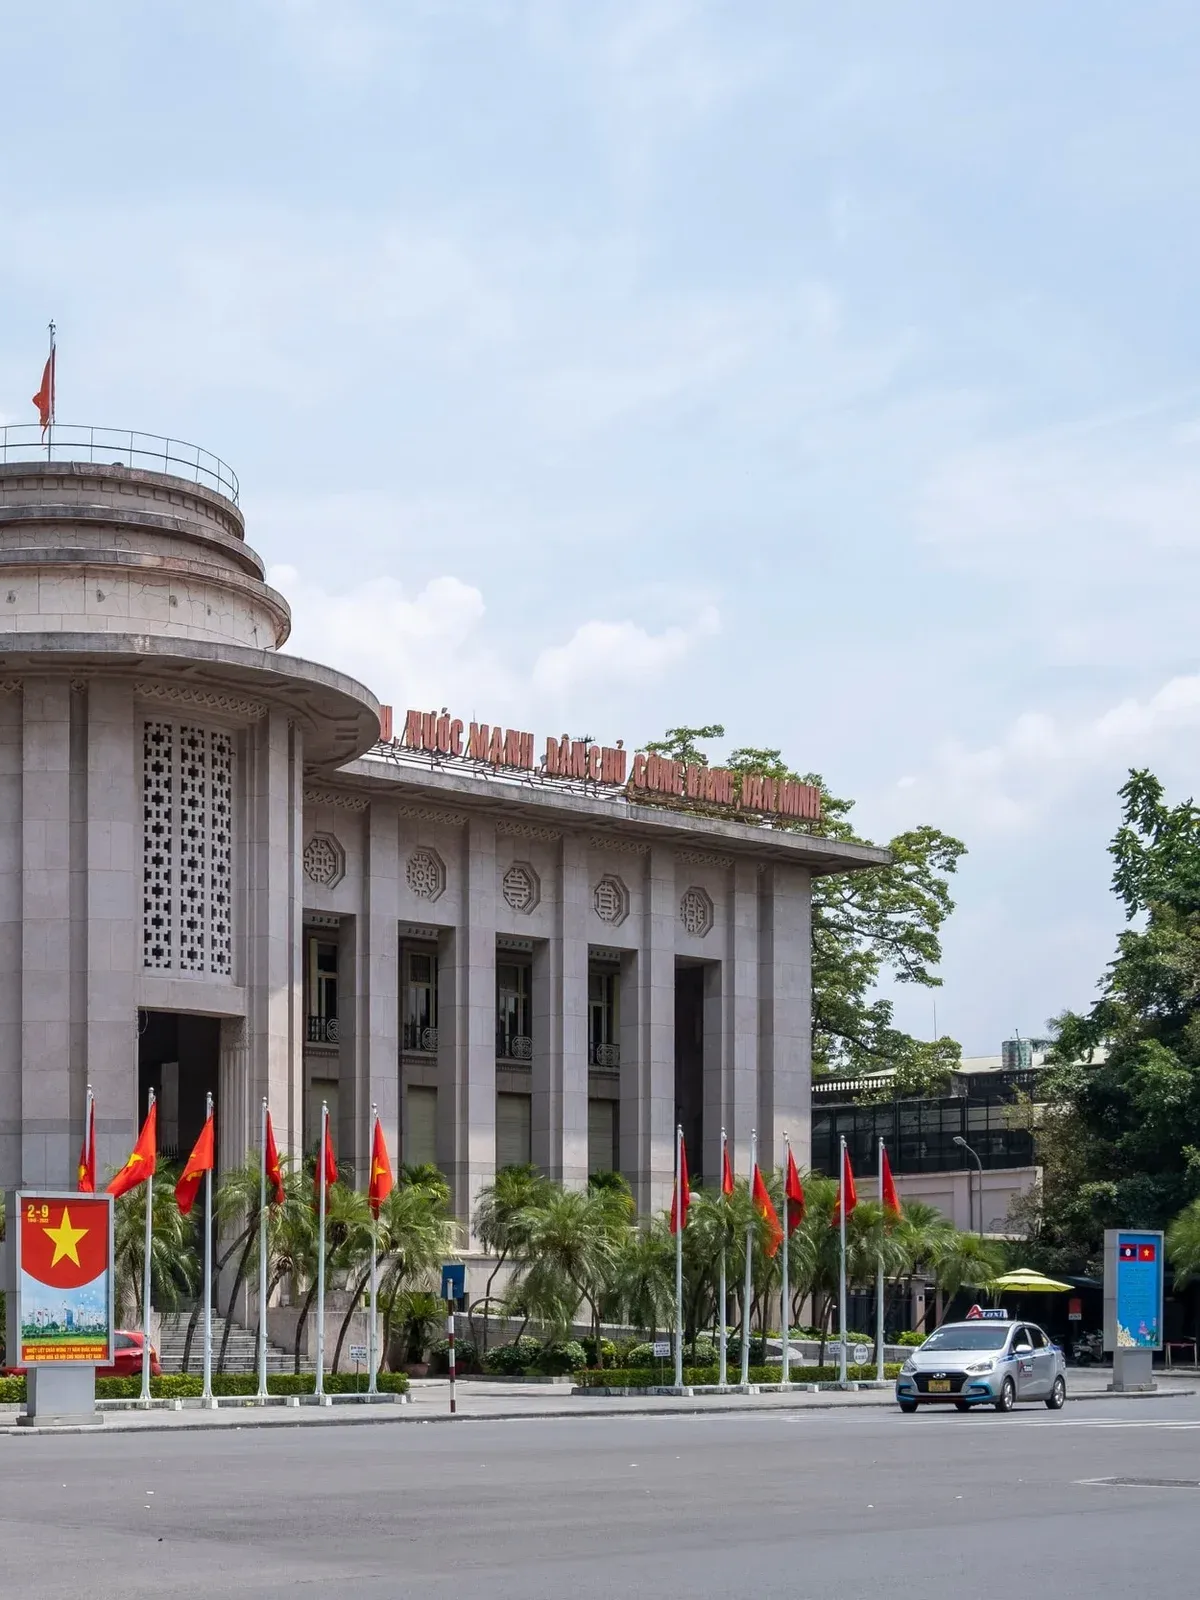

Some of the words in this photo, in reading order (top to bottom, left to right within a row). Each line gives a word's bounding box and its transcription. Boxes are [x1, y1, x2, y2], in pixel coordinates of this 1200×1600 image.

[406, 707, 464, 756] NƯỚC
[546, 733, 585, 779] DÂN
[634, 750, 684, 796] CÔNG
[779, 778, 821, 820] MINH
